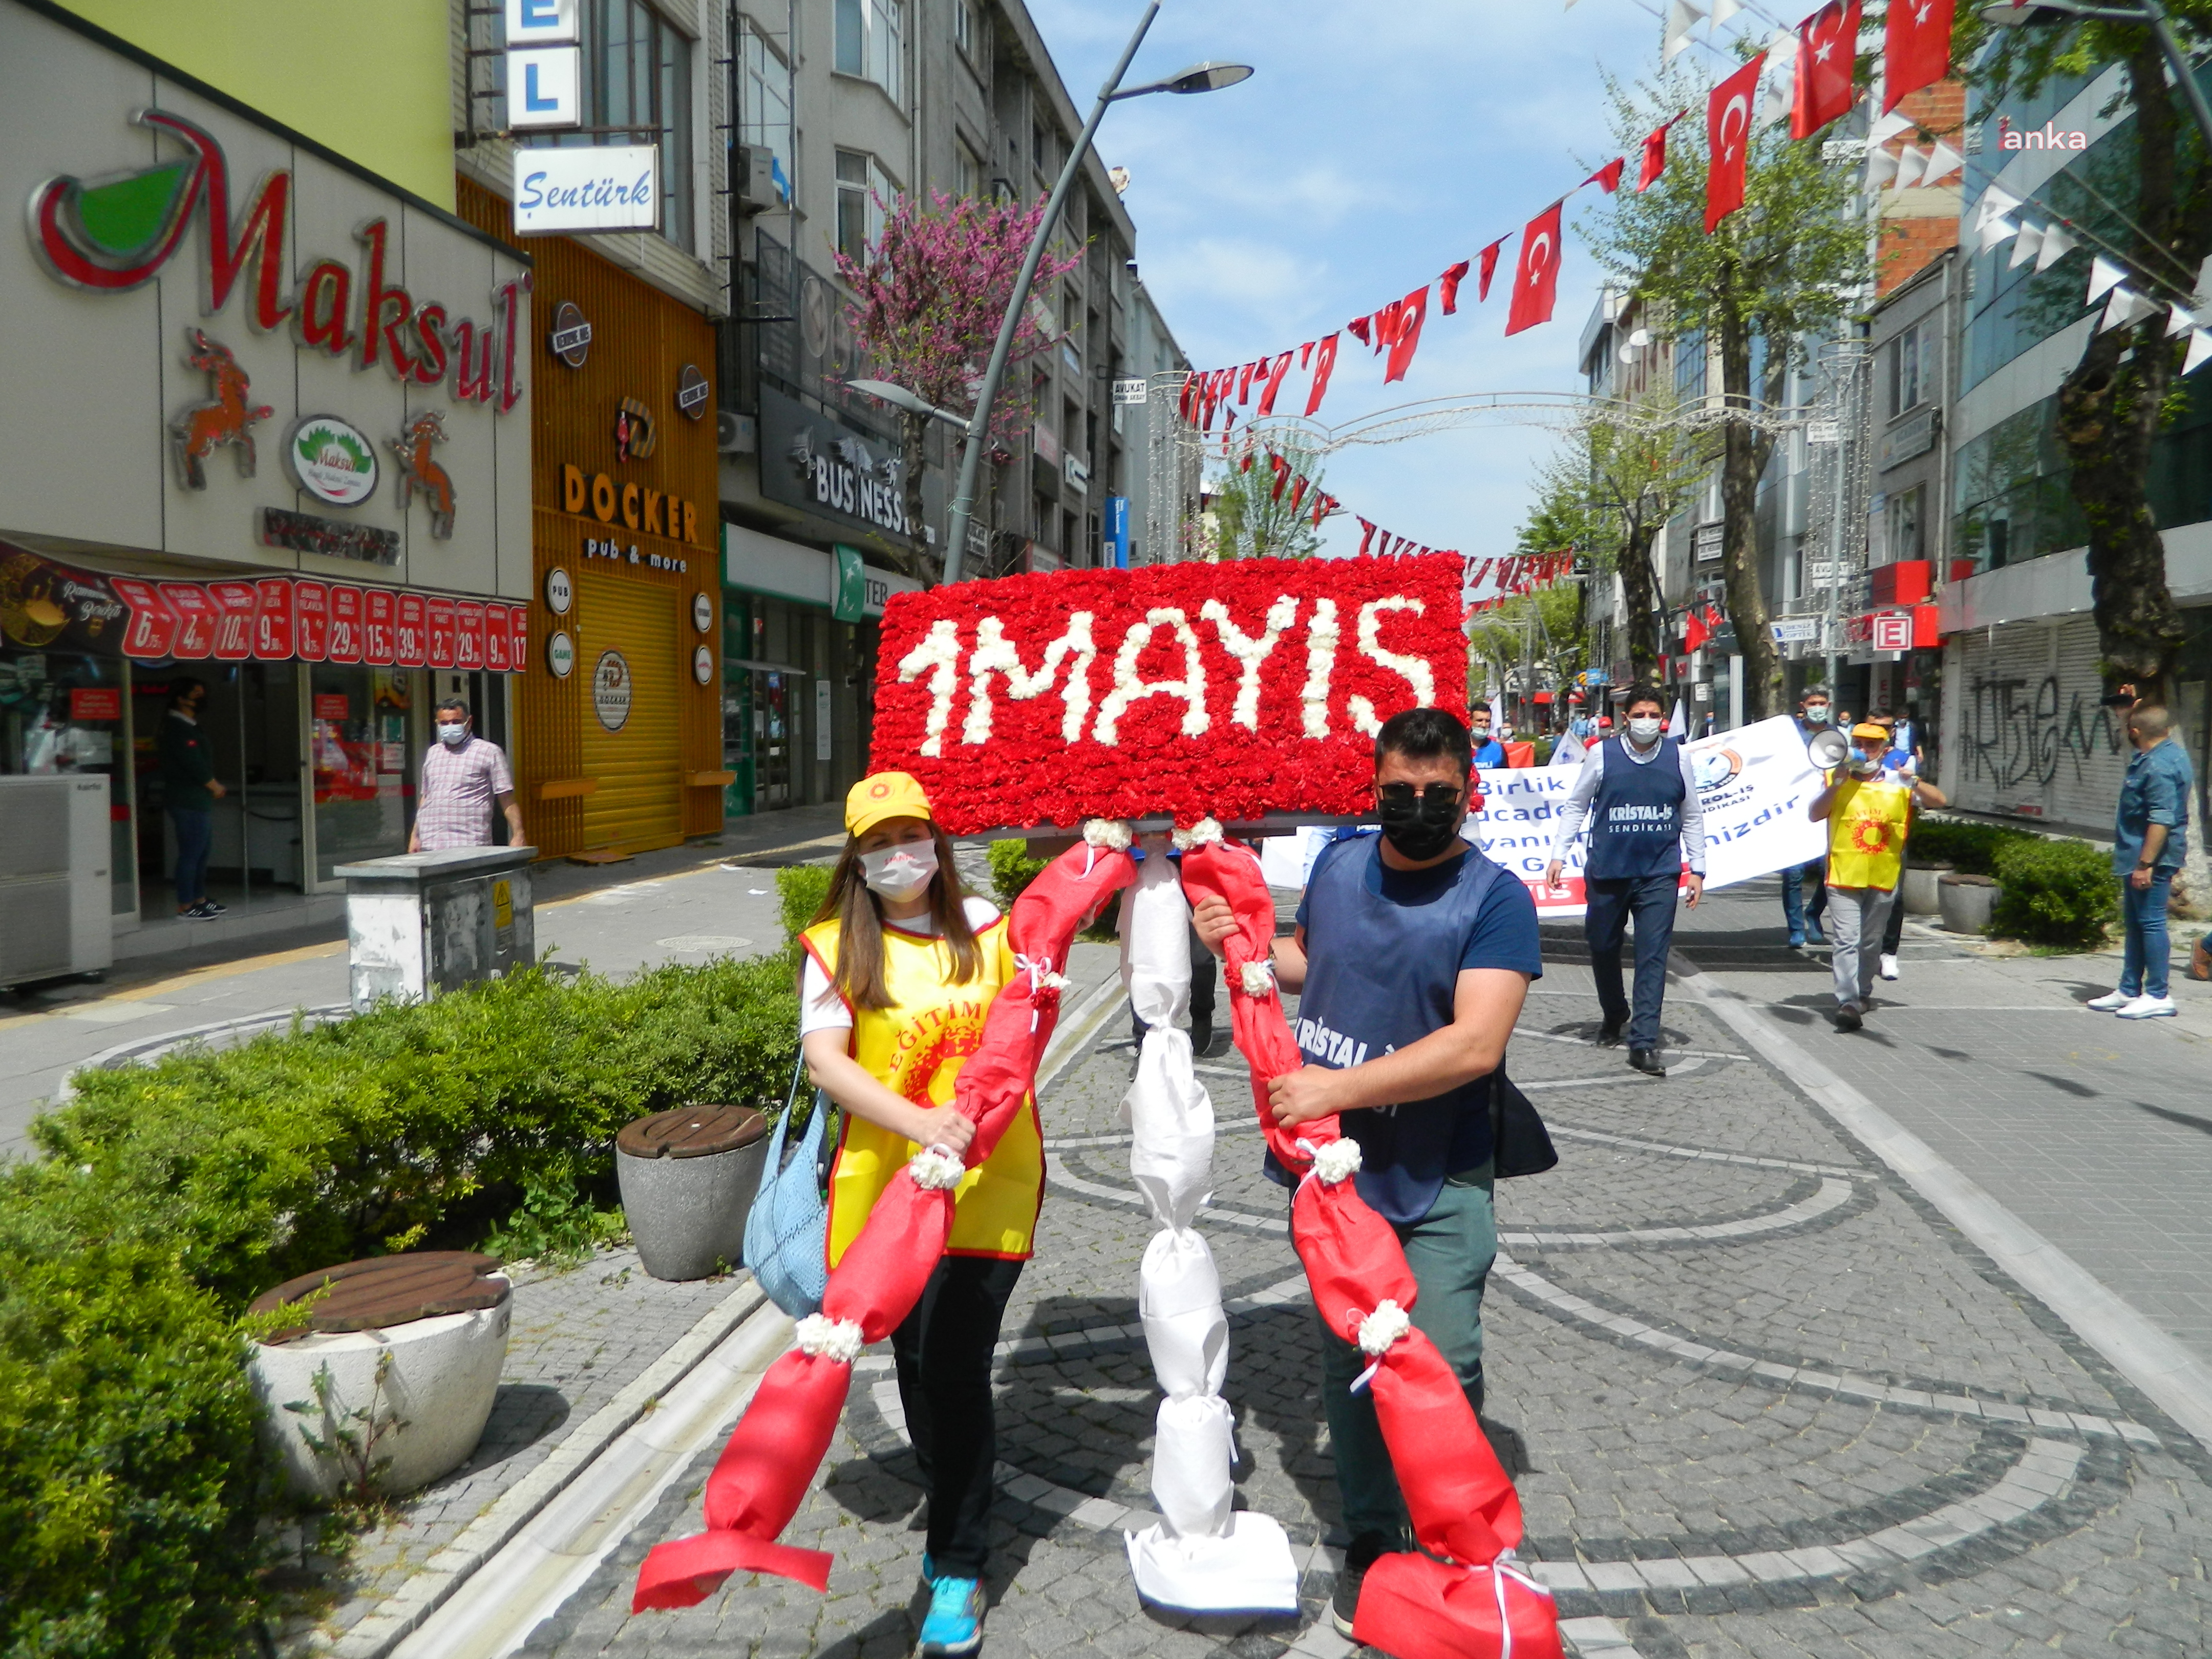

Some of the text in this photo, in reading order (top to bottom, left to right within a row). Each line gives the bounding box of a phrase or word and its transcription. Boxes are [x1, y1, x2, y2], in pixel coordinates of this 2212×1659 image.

[518, 168, 651, 219] Şentürk
[1115, 383, 1145, 393] AVUKAT
[563, 463, 698, 544] DOCKER
[587, 539, 688, 573] pub & more
[552, 585, 569, 597] PUB
[865, 579, 889, 607] TEB
[554, 647, 571, 660] GAME
[598, 695, 627, 705] DOCKER
[1477, 776, 1566, 796] Birlik
[889, 998, 982, 1073] EĞİTİM
